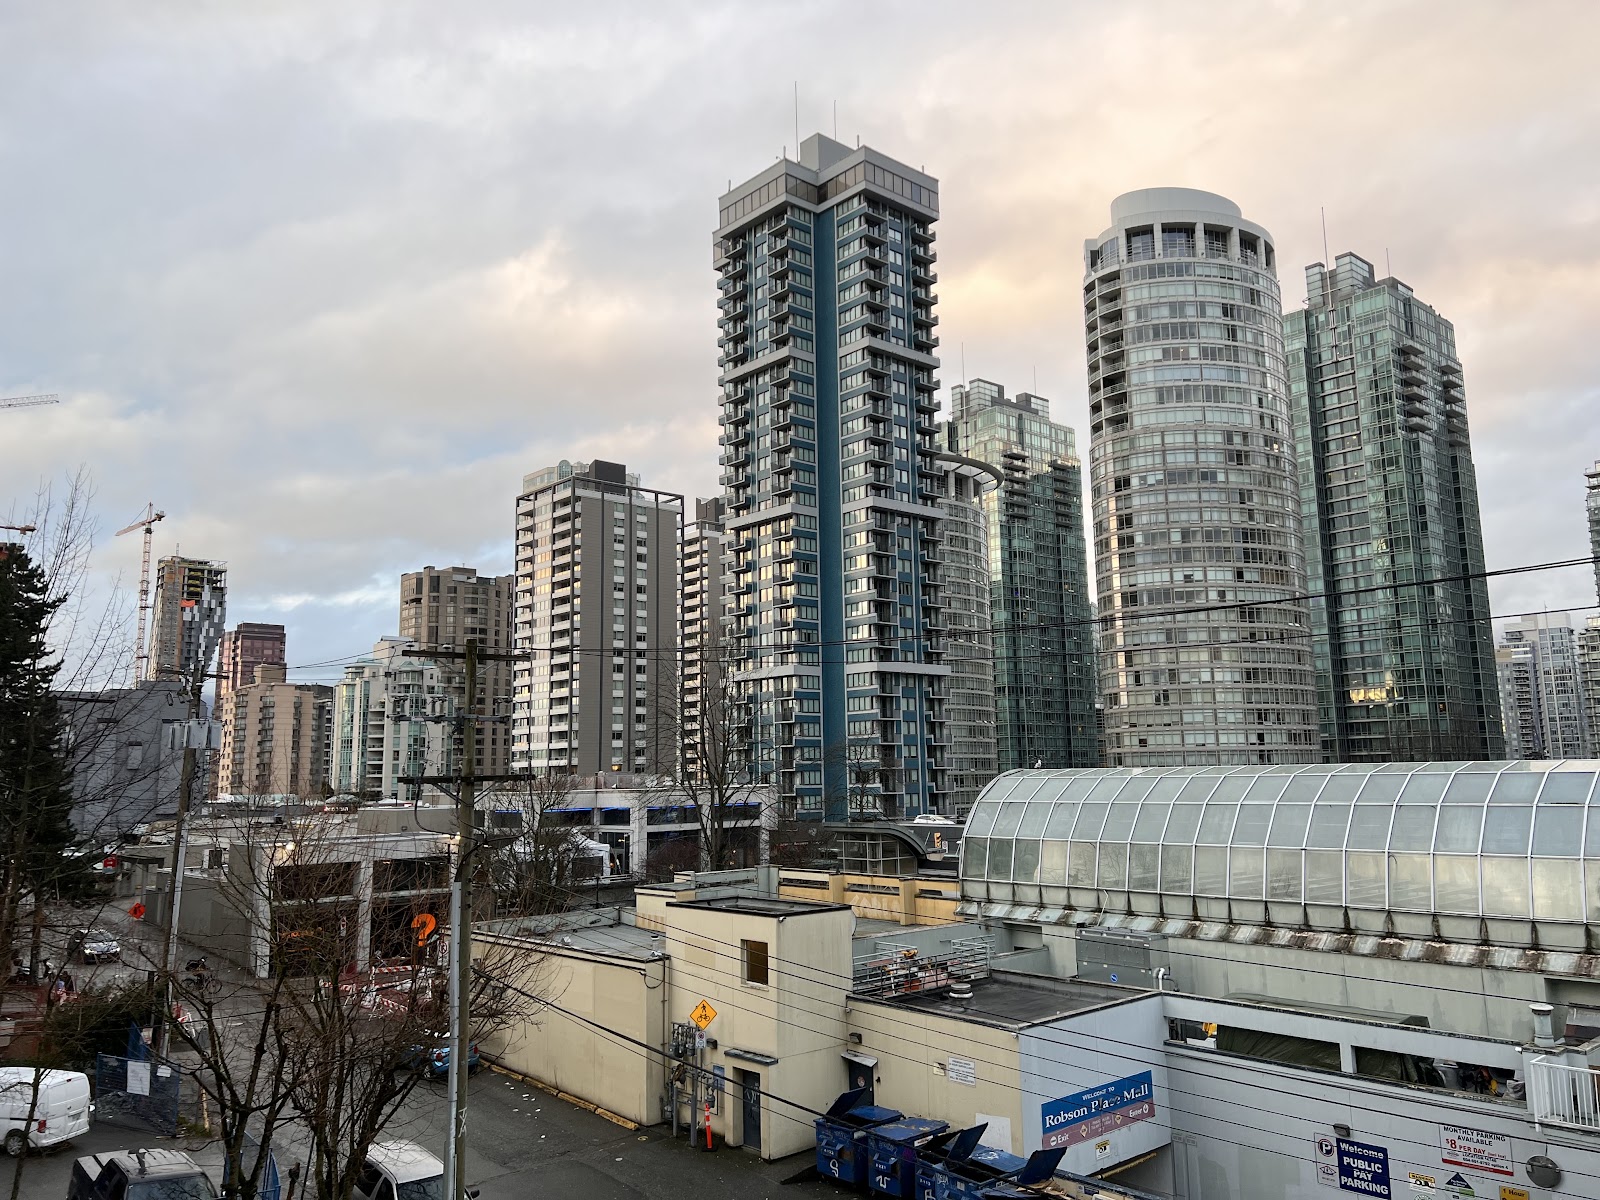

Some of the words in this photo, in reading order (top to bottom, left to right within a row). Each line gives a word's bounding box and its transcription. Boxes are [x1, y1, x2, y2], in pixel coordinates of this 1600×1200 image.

[1045, 1106, 1088, 1128] Robson
[1091, 1095, 1121, 1112] Place
[1123, 1083, 1149, 1101] Mall
[1129, 1108, 1142, 1118] Enter
[1057, 1132, 1069, 1143] Exit
[1443, 1125, 1475, 1137] MONTHLY
[1476, 1131, 1506, 1142] PARKING
[1457, 1135, 1493, 1147] AVAILABLE
[1339, 1141, 1384, 1160] Welcome
[1458, 1144, 1472, 1152] PER
[1473, 1147, 1486, 1155] DAY
[1343, 1156, 1383, 1173] PUBLIC
[1353, 1169, 1374, 1181] PAY
[1340, 1175, 1389, 1195] PARKING
[1508, 1189, 1525, 1198] Hour
